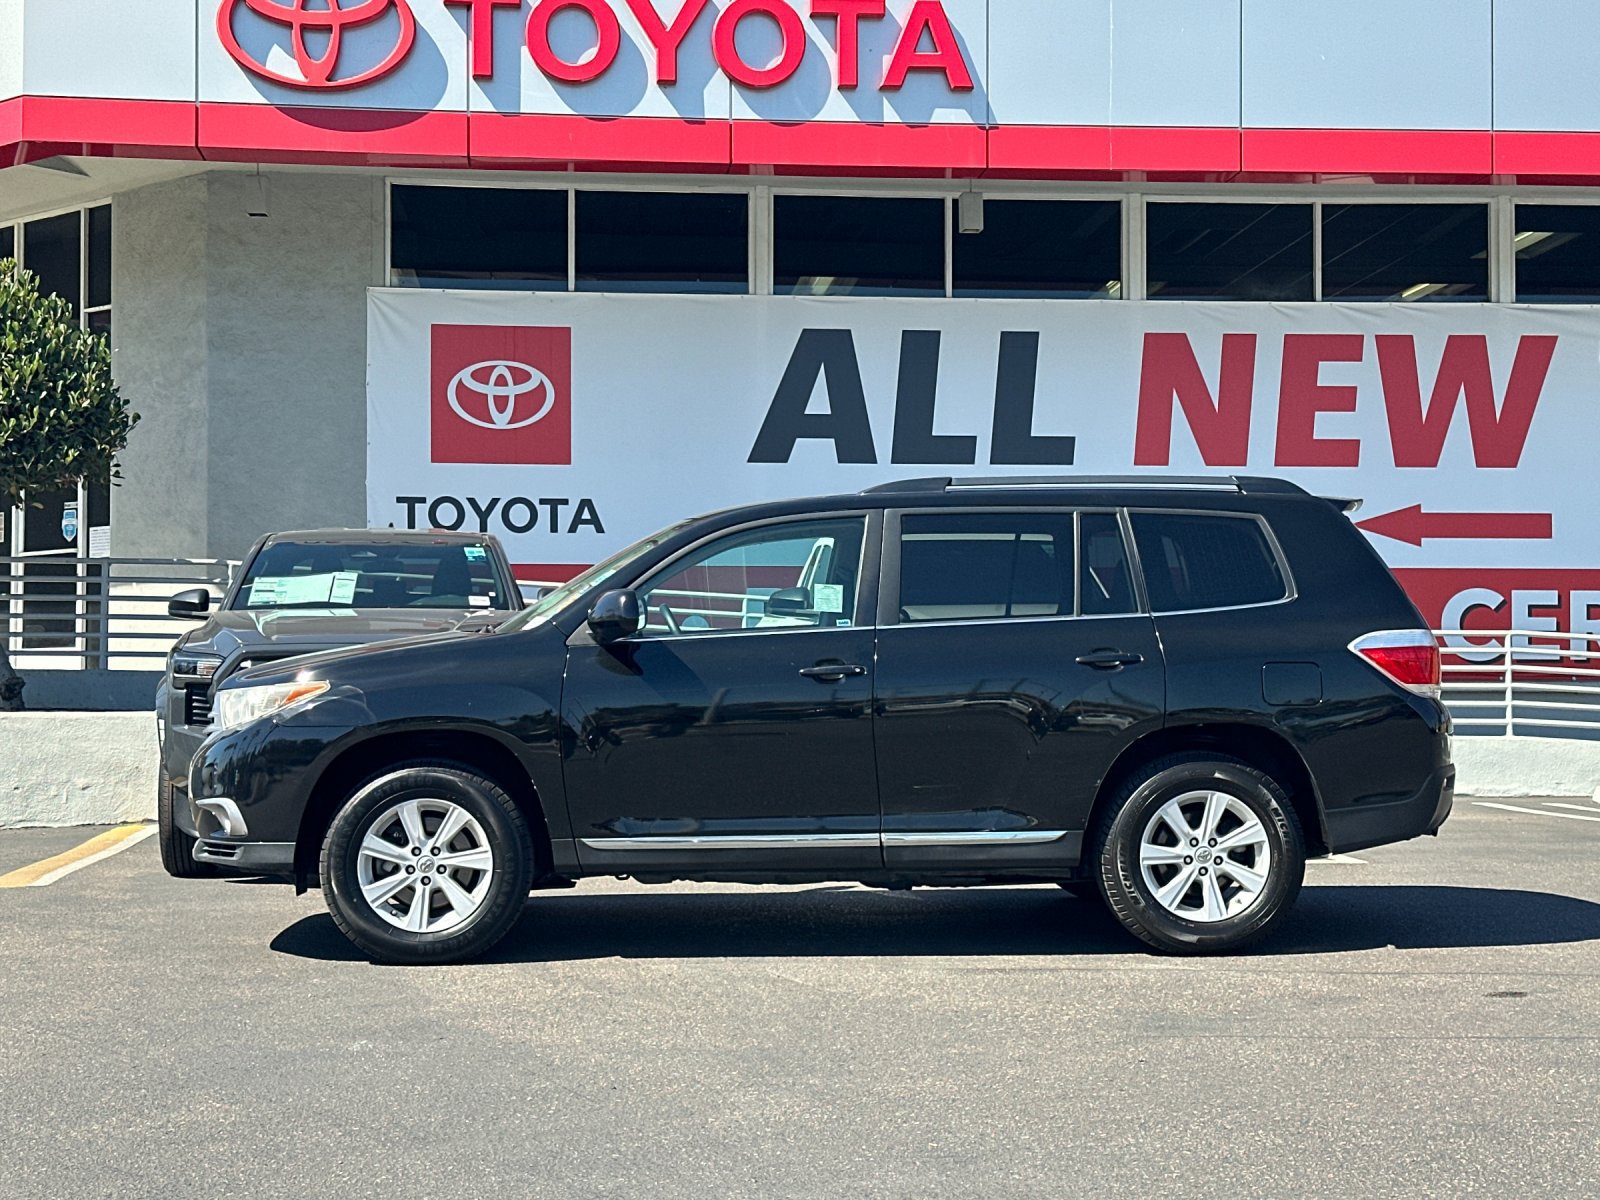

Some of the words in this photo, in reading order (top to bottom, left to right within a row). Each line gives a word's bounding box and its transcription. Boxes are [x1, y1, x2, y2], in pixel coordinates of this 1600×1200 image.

[443, 0, 974, 91] TOYOTA
[747, 328, 1076, 465] ALL
[1134, 332, 1559, 468] NEW
[396, 496, 605, 533] TOYOTA
